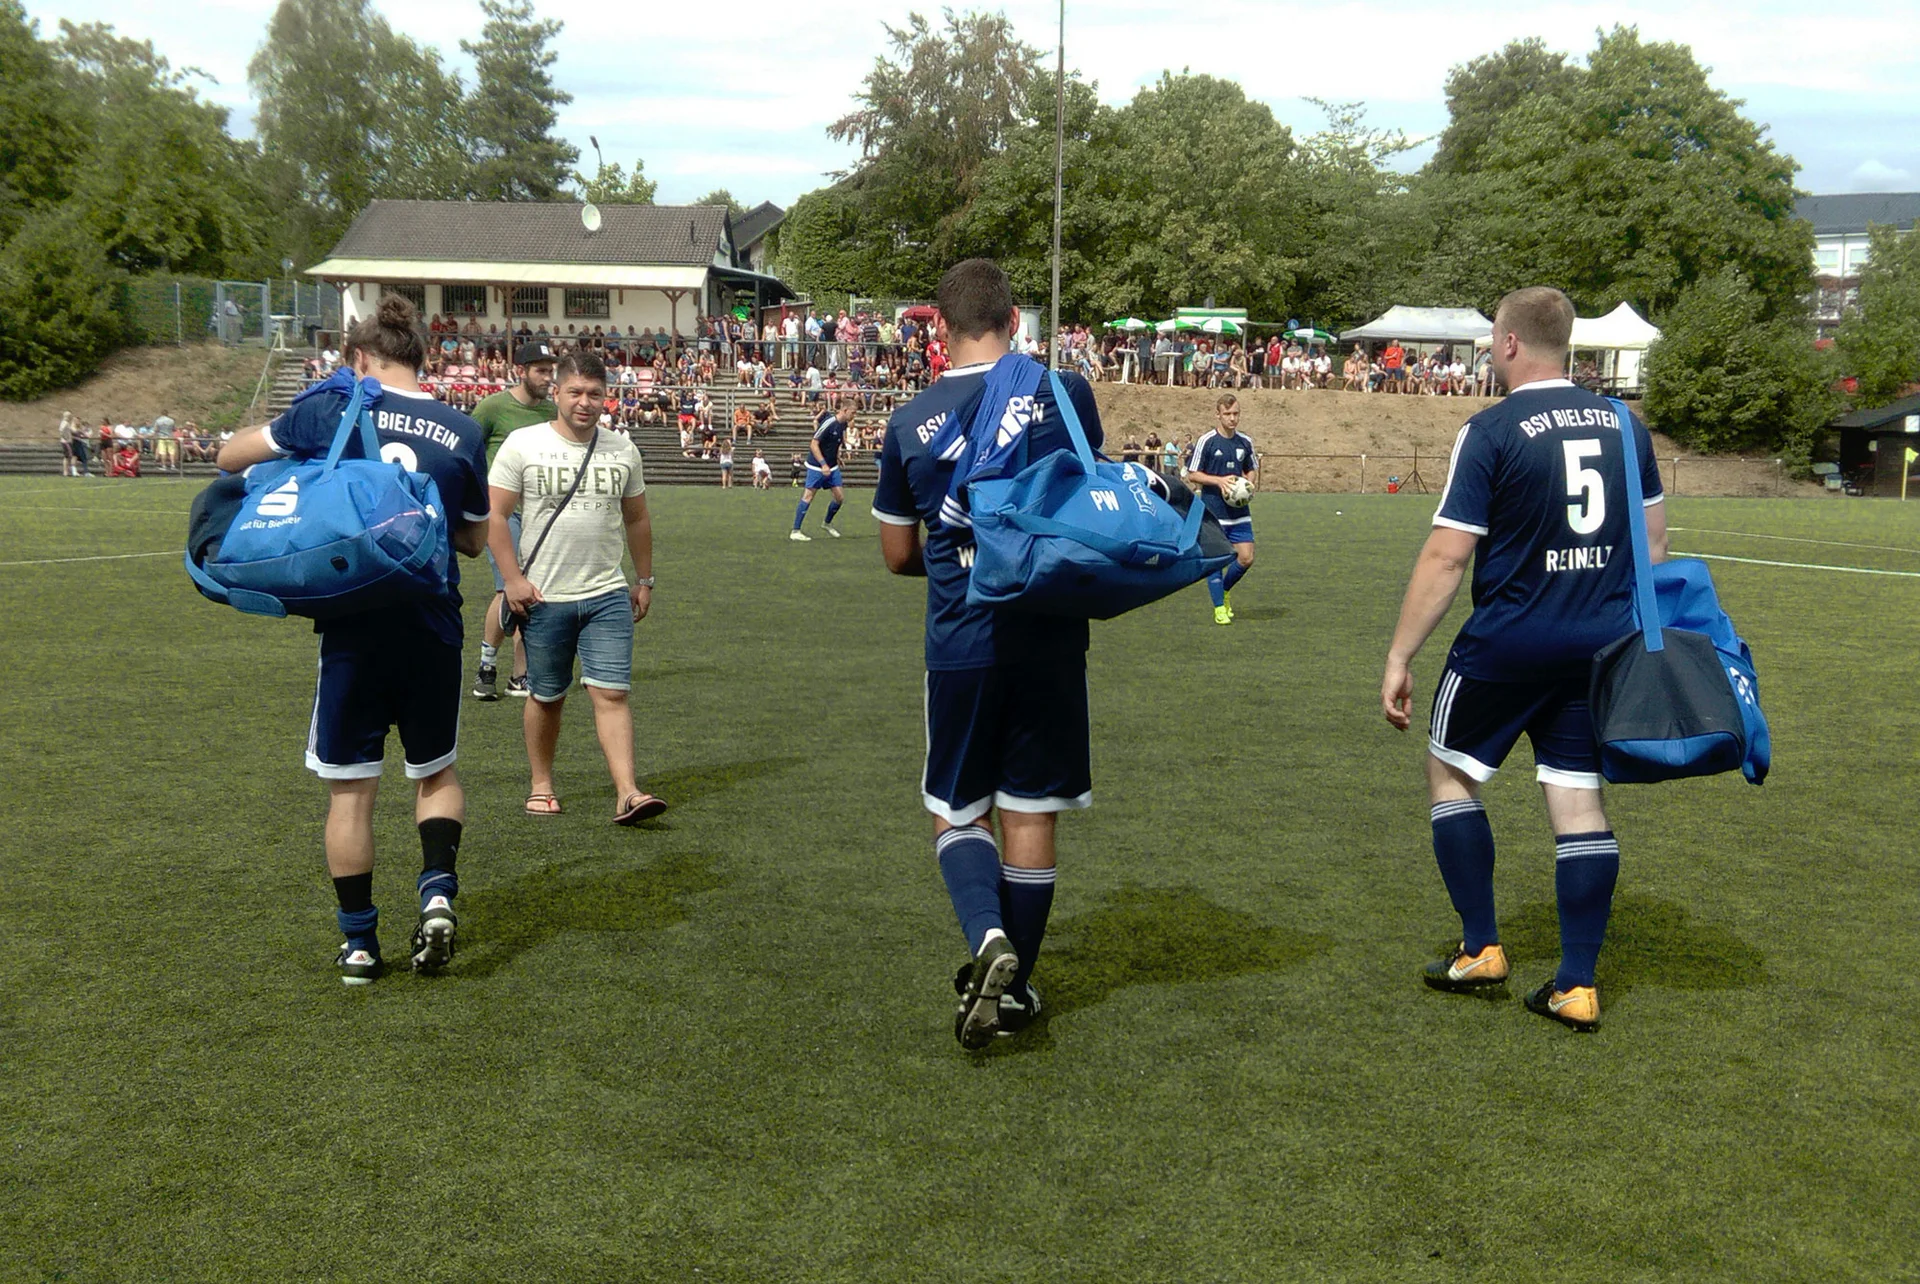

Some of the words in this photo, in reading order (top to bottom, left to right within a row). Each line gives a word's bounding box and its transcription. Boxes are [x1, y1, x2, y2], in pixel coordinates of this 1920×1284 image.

[378, 410, 460, 451] BIELSTEIN
[1519, 412, 1552, 438] BSV
[539, 452, 569, 461] THE
[537, 466, 622, 496] NEVER
[1562, 438, 1606, 535] 5
[550, 501, 612, 511] EEPS
[1089, 490, 1120, 512] PW
[1545, 545, 1614, 572] REINELT
